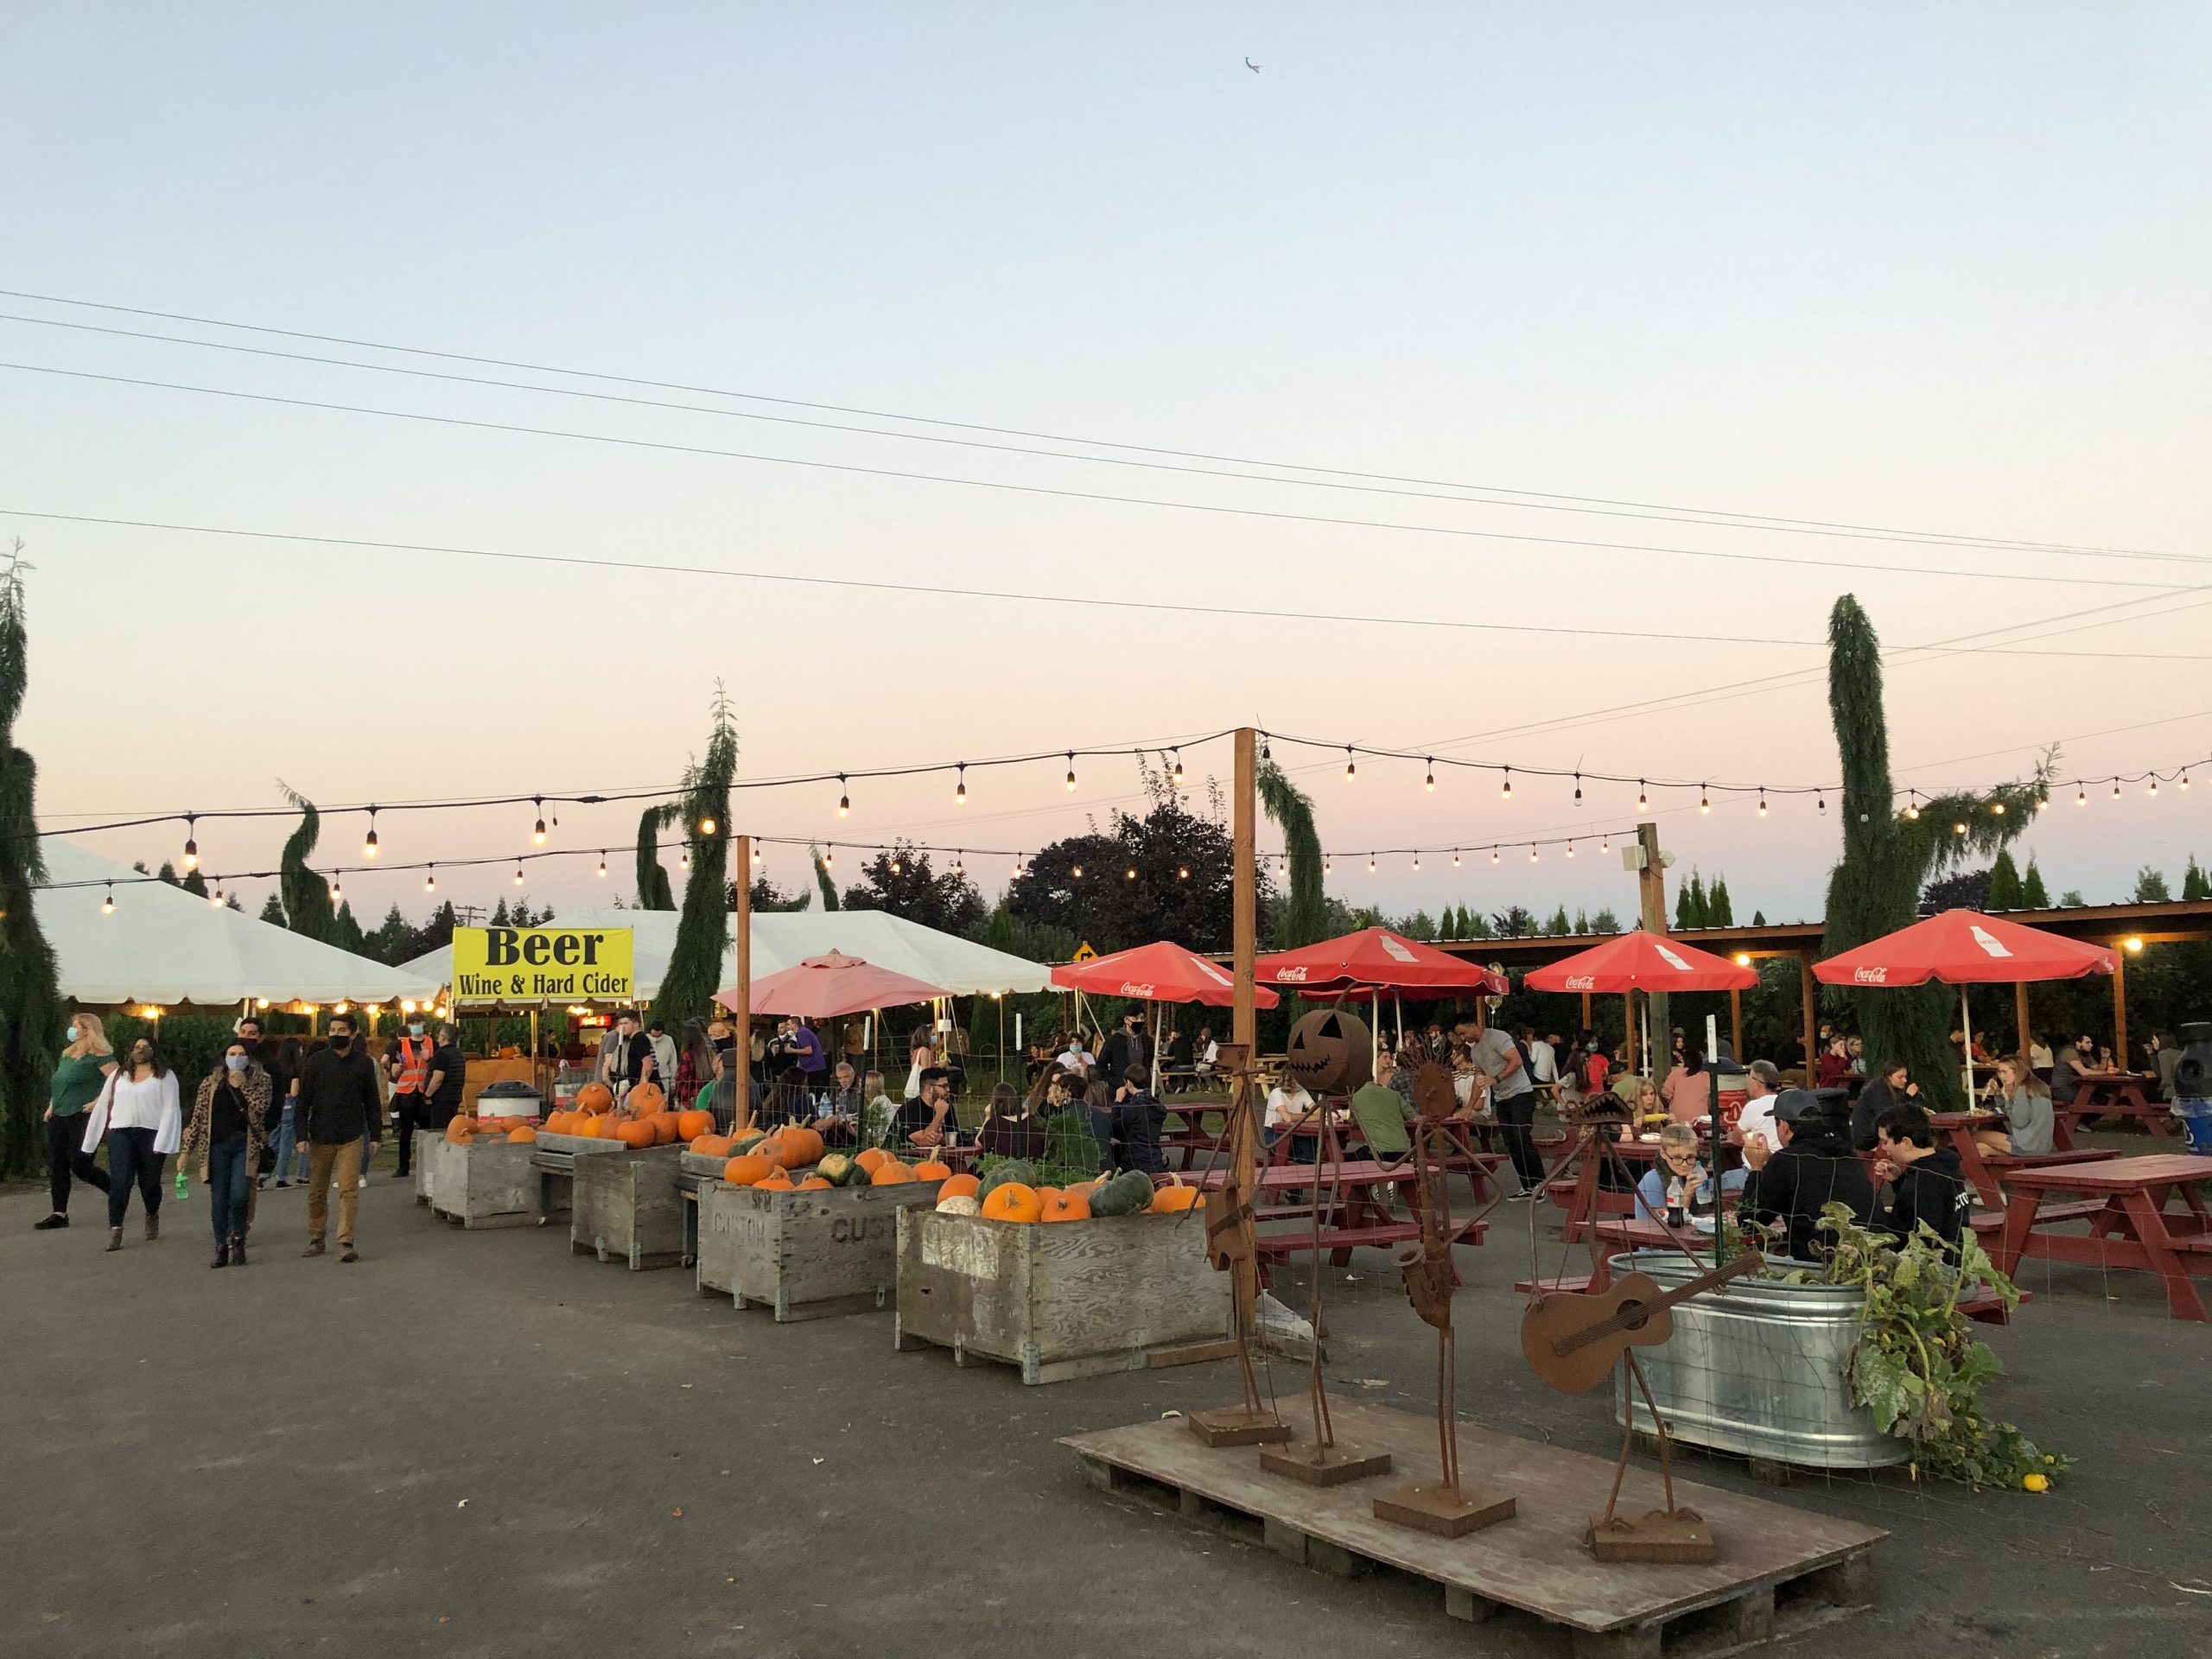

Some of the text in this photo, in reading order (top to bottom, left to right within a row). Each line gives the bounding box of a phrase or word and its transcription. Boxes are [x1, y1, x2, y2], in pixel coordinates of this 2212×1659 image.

[486, 928, 604, 966] Beer
[459, 971, 629, 995] Wine & Hard Cider
